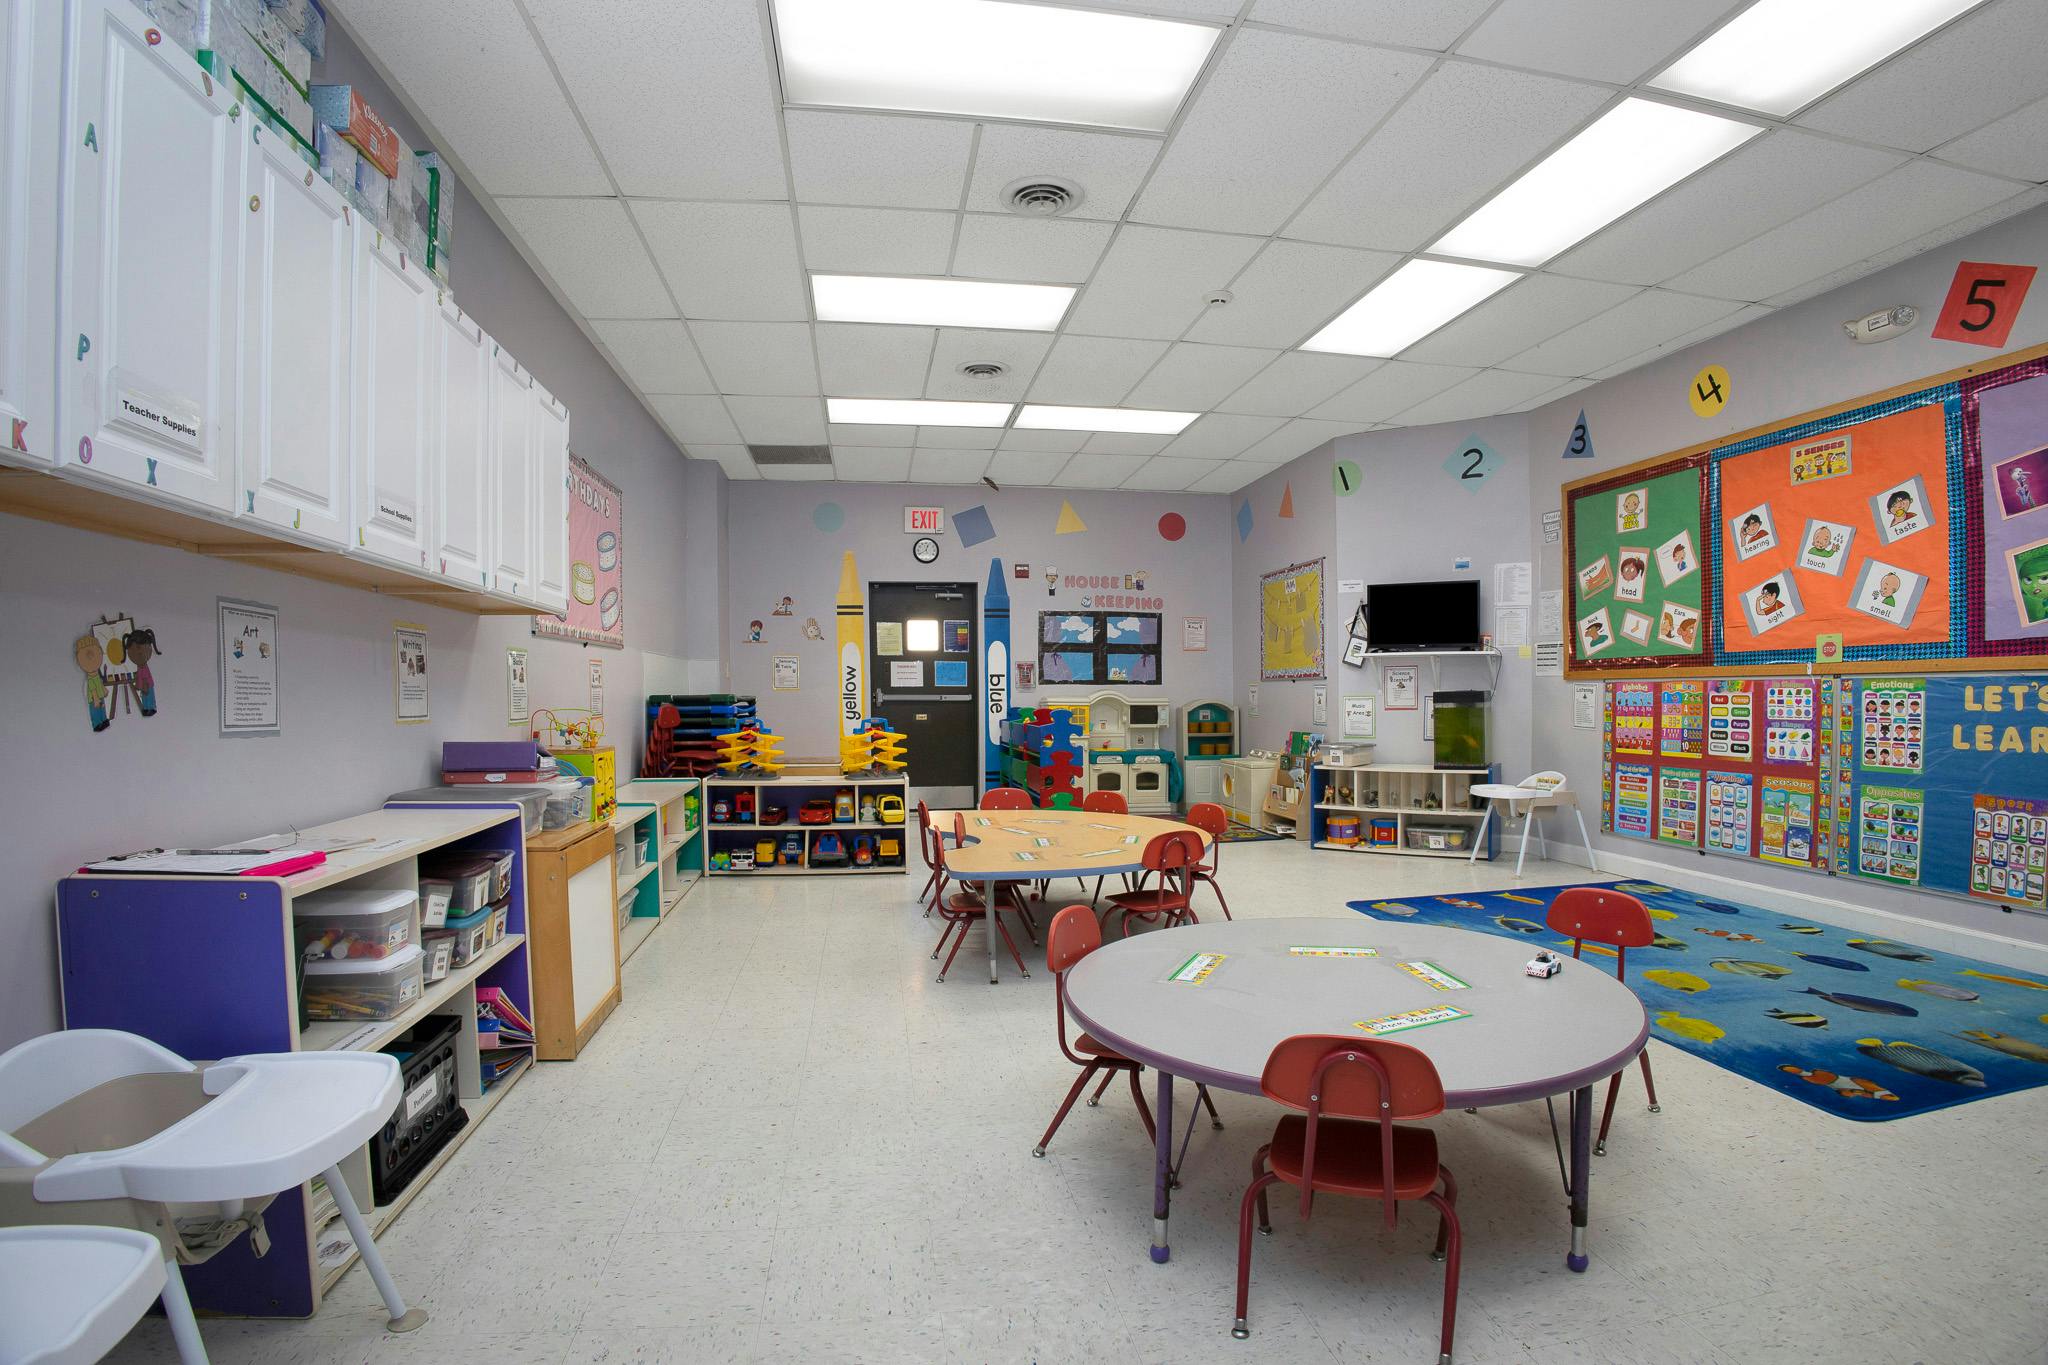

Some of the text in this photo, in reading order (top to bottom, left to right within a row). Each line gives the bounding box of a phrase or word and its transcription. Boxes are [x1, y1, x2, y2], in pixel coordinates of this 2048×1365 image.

[84, 122, 98, 152] A
[1960, 279, 2006, 332] 5
[77, 334, 90, 362] P
[1697, 373, 1723, 404] 4
[123, 400, 197, 437] Teacher Supplies
[12, 418, 28, 451] K
[1571, 424, 1587, 455] 3
[1804, 440, 1845, 456] SENSES
[146, 457, 158, 486] X
[1461, 448, 1484, 480] 2
[1338, 466, 1349, 491] 1
[911, 510, 938, 529] EXIT
[1895, 521, 1917, 536] taste
[1744, 538, 1770, 554] hearing
[1806, 558, 1826, 569] touch
[1583, 565, 1598, 578] HANDS
[1064, 575, 1120, 589] HOUSE
[1621, 587, 1637, 597] head
[1095, 595, 1163, 610] KEEPING
[1767, 611, 1785, 624] sight
[1870, 605, 1892, 618] smell
[243, 625, 259, 638] Art
[402, 639, 422, 653] Writing
[1823, 645, 1836, 653] STOP
[1622, 683, 1648, 692] Alphabet
[1871, 681, 1914, 689] Emotions
[843, 666, 861, 720] yellow
[989, 674, 1005, 713] blue
[1713, 774, 1744, 784] Weather
[1766, 778, 1812, 789] Seasons
[1866, 787, 1920, 800] Opposites
